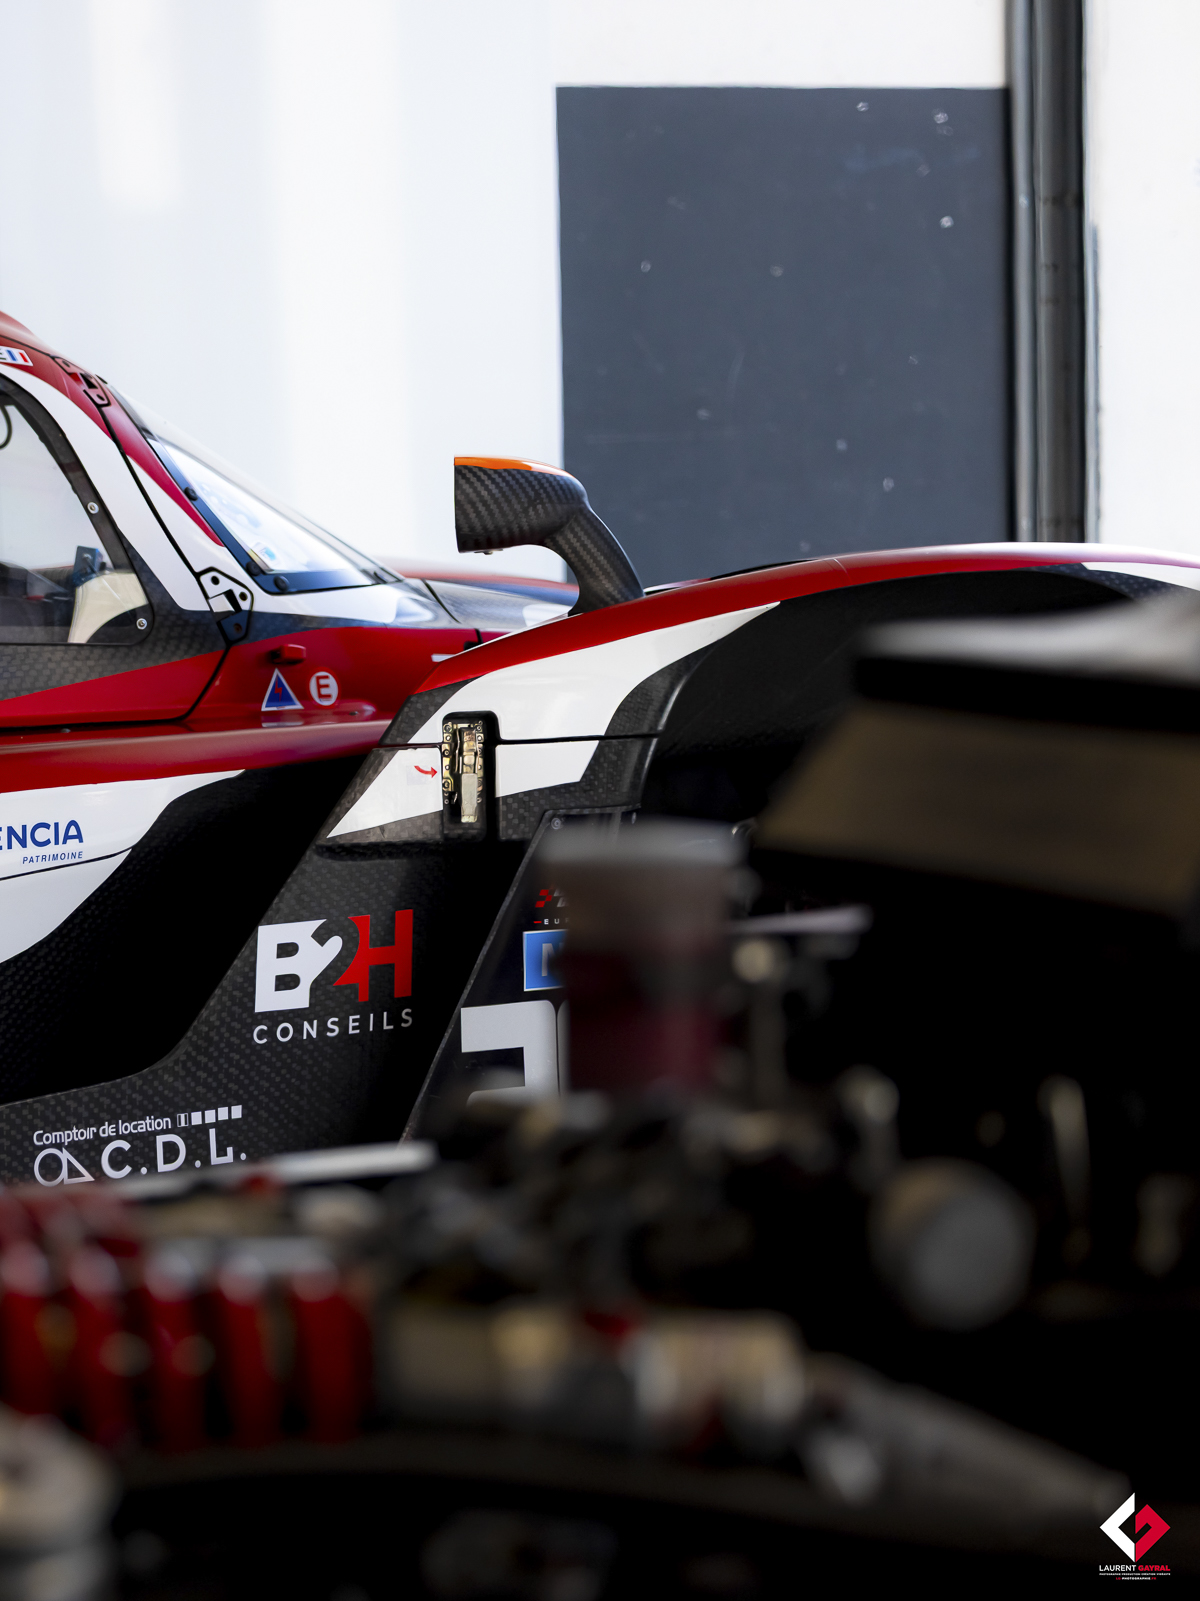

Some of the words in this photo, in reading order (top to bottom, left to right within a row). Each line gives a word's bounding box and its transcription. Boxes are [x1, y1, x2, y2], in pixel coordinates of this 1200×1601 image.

[315, 674, 333, 700] E
[22, 850, 84, 864] PATRIMOINE
[255, 909, 414, 1013] B2H
[253, 1008, 413, 1044] CONSEILS
[33, 1125, 97, 1146] Comptoir
[100, 1121, 116, 1137] de
[119, 1115, 171, 1136] location
